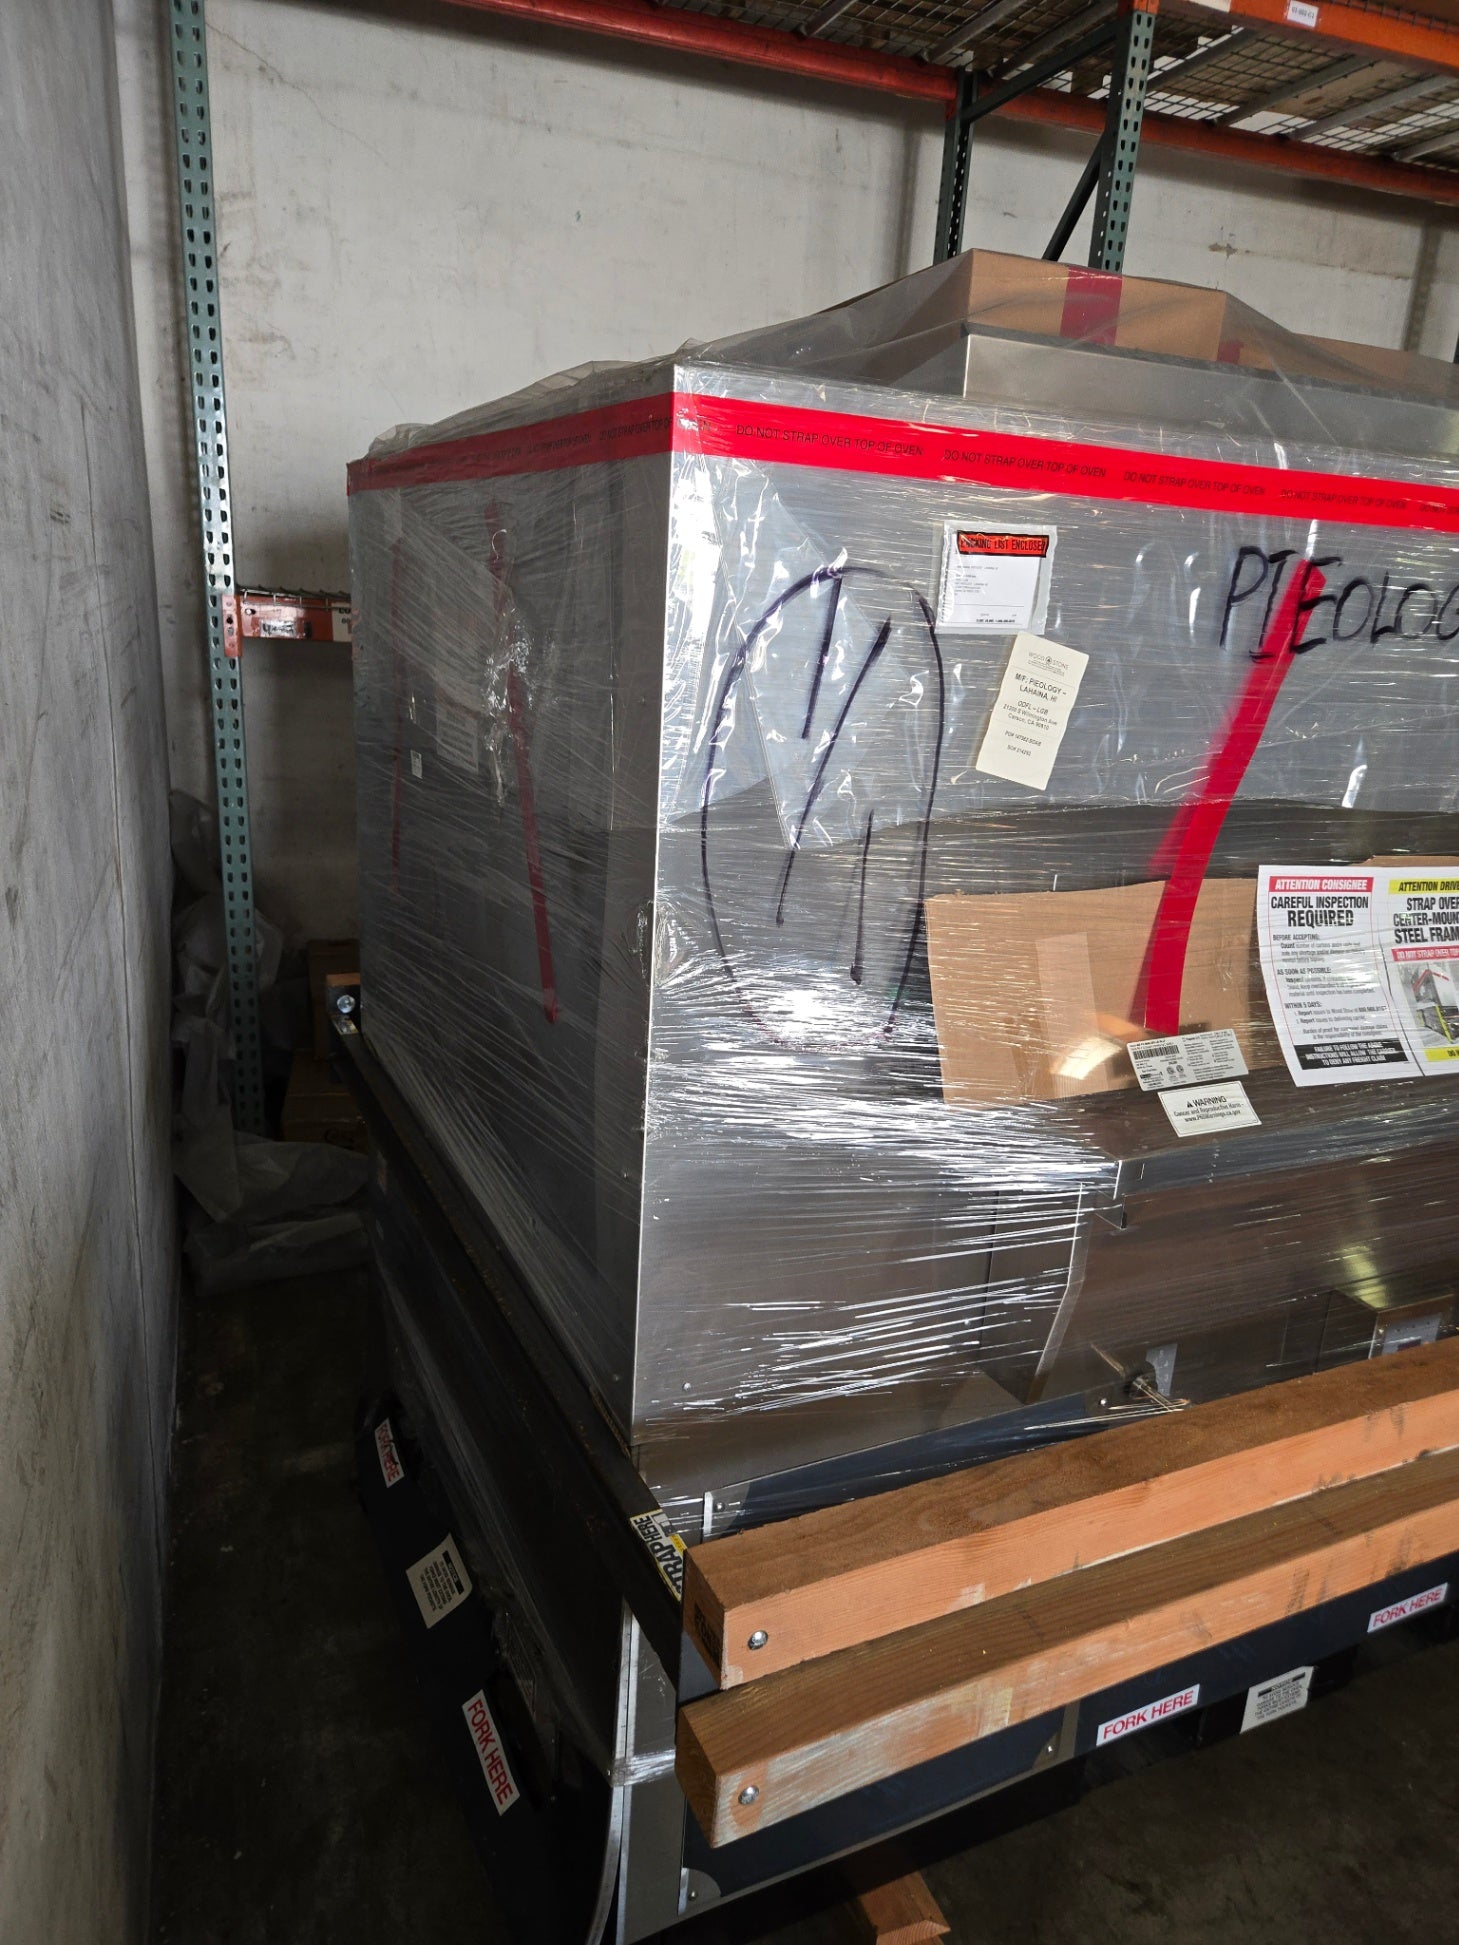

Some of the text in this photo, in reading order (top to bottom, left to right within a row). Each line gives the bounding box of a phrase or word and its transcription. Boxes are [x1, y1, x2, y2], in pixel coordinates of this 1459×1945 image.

[736, 424, 924, 455] DO NOT STRAP OVER TOP OF OVEN
[944, 450, 1106, 477] DO NOT STRAP OVER TOP OF OVEN
[1124, 471, 1264, 494] DO NOT STRAP OVER TOP OF OVEN
[995, 540, 1008, 550] LIST
[1029, 678, 1062, 695] PIEOLOGY
[1275, 879, 1367, 890] ATTENTION CONSIGNEE
[1398, 880, 1438, 892] ATTENTION
[1271, 896, 1368, 908] CAREFUL INSPECTION
[1407, 897, 1436, 911] STRAP
[1288, 910, 1353, 928] REQUIRED
[1395, 928, 1428, 944] STEEL
[1417, 950, 1434, 959] STRAP
[1193, 1096, 1227, 1107] WARNING
[634, 1515, 663, 1542] HERE
[1373, 1587, 1443, 1627] FORK HERE
[1103, 1690, 1194, 1739] FORK HERE
[467, 1698, 513, 1805] FORK HERE
